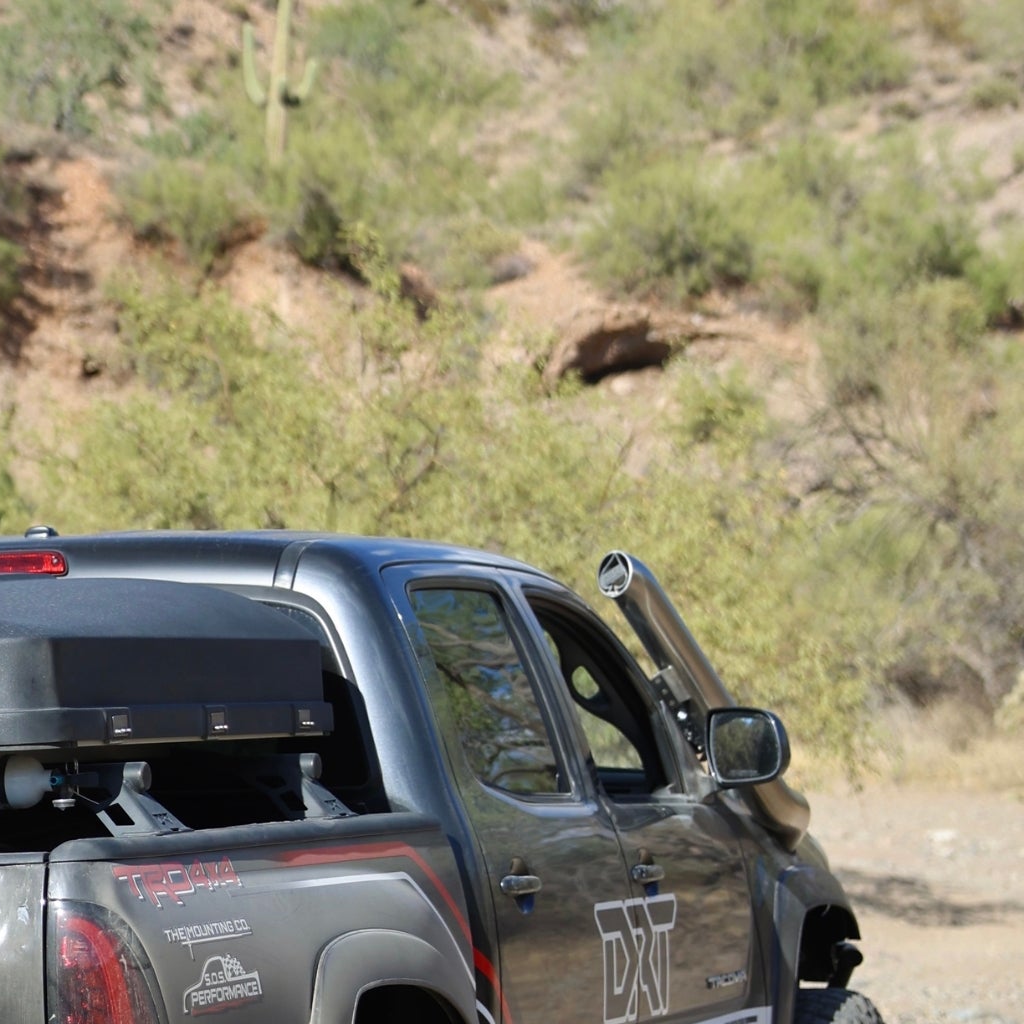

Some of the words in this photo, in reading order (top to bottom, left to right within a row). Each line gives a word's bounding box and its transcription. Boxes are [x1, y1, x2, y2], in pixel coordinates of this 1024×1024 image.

[112, 862, 195, 908] TRD
[164, 929, 186, 942] THE
[186, 920, 234, 939] MOUNTING
[234, 919, 251, 931] CO.
[204, 971, 227, 986] S.O.S.
[191, 981, 259, 1007] PERFORMANCE
